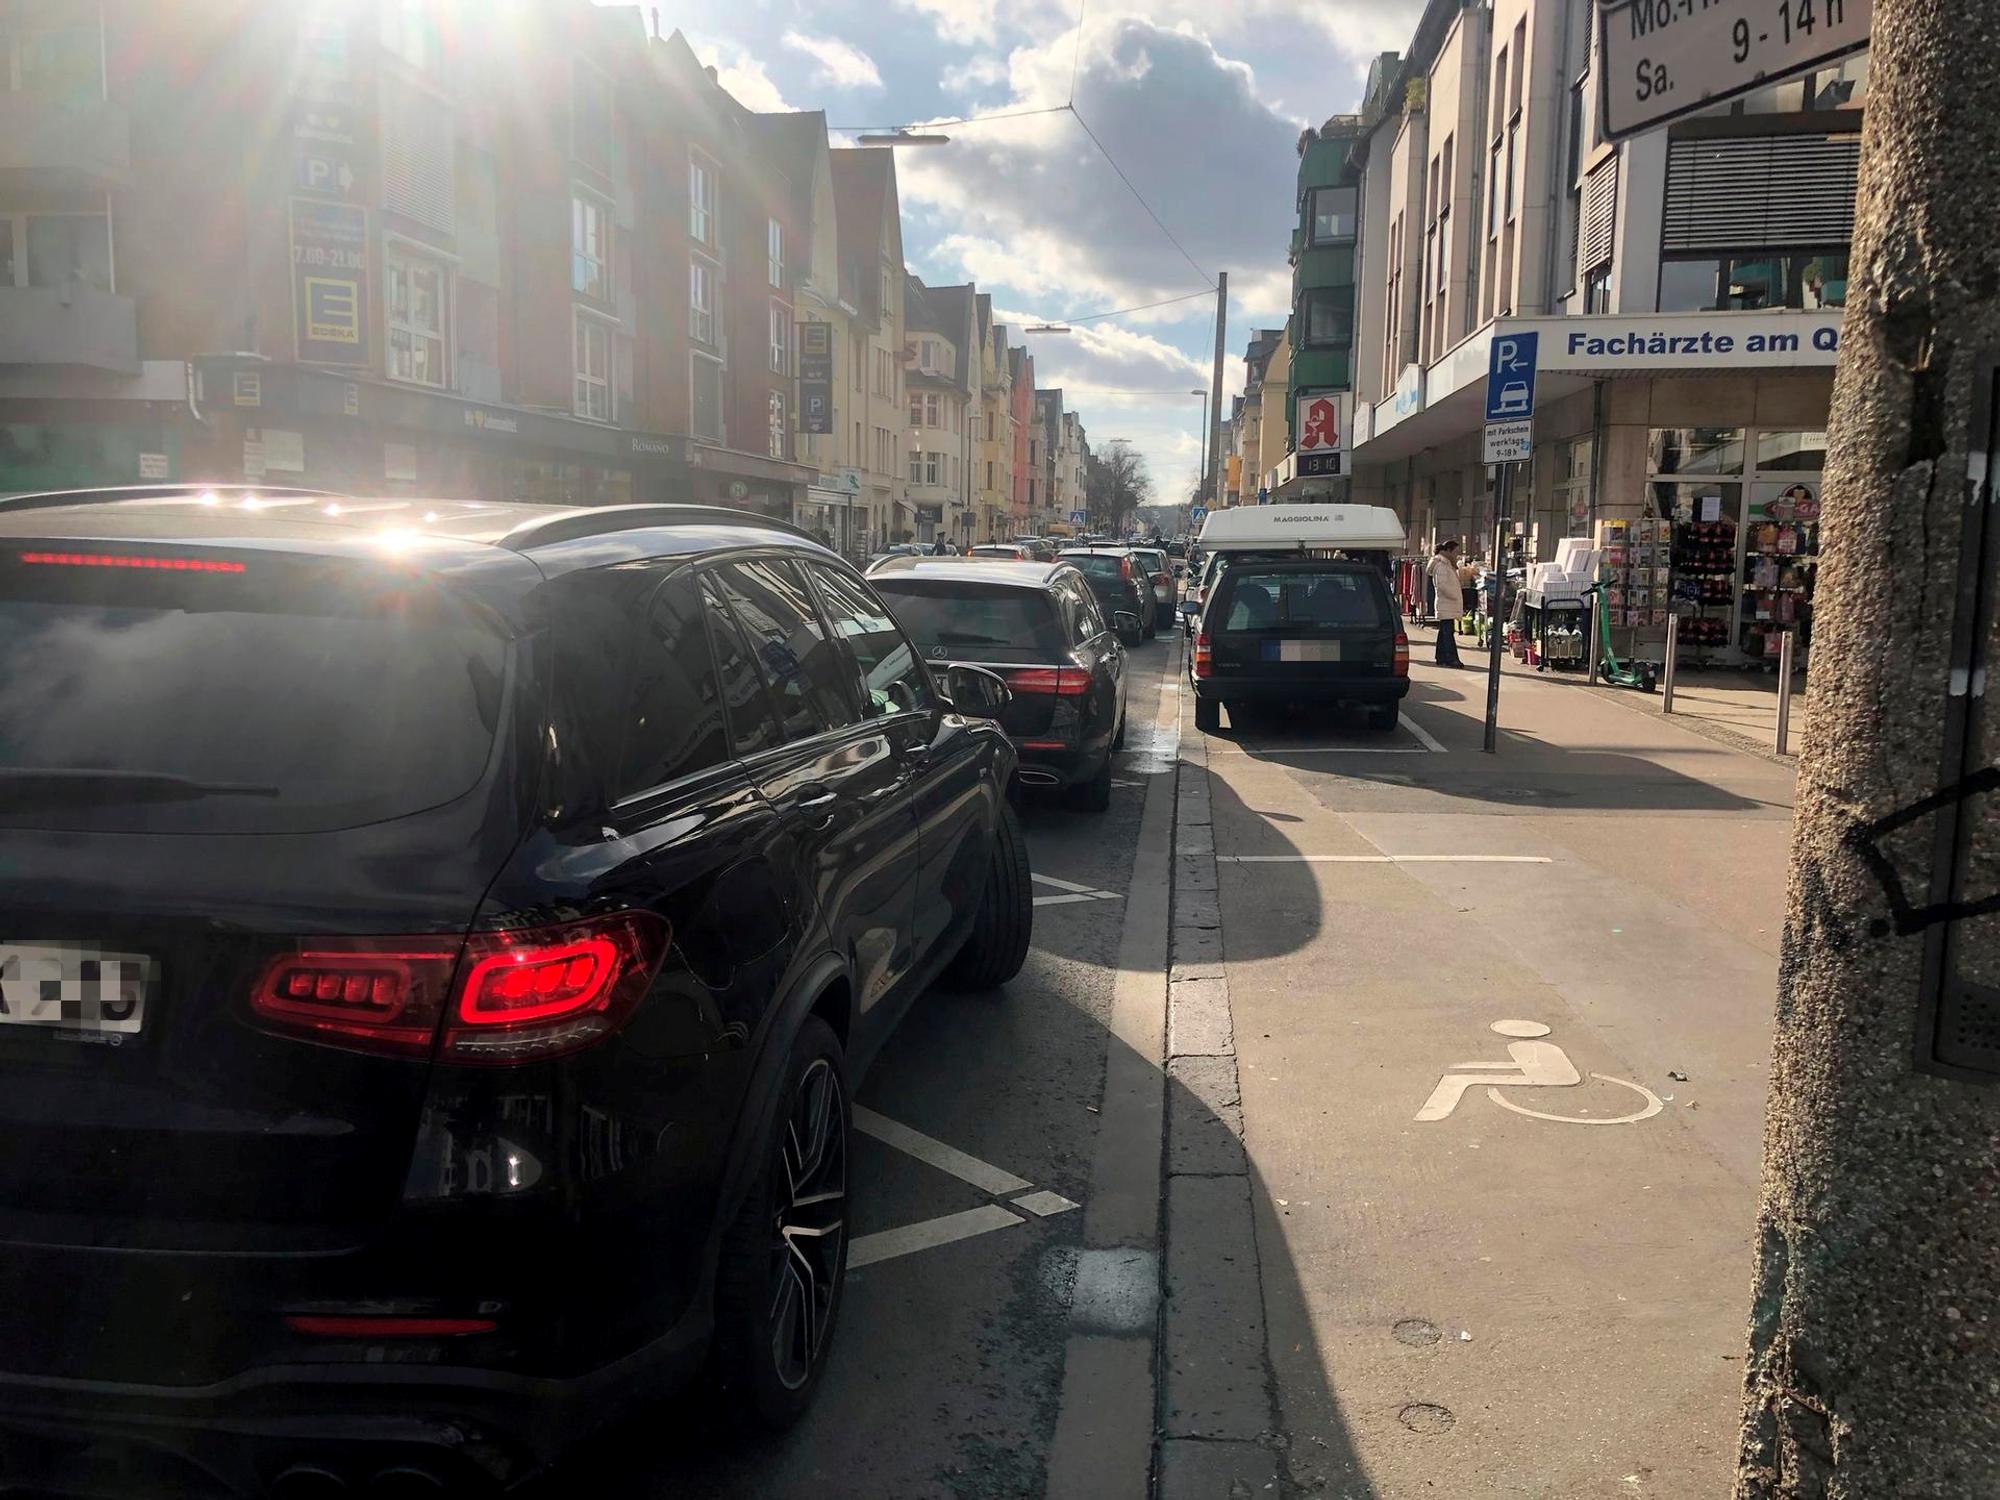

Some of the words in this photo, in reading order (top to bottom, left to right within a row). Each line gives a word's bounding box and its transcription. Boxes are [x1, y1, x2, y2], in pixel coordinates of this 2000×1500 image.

[1636, 58, 1675, 102] Sa.
[1568, 330, 1734, 356] Fachärzte
[1746, 334, 1799, 352] am
[1498, 426, 1529, 435] Parkschein
[1490, 438, 1525, 447] werktags
